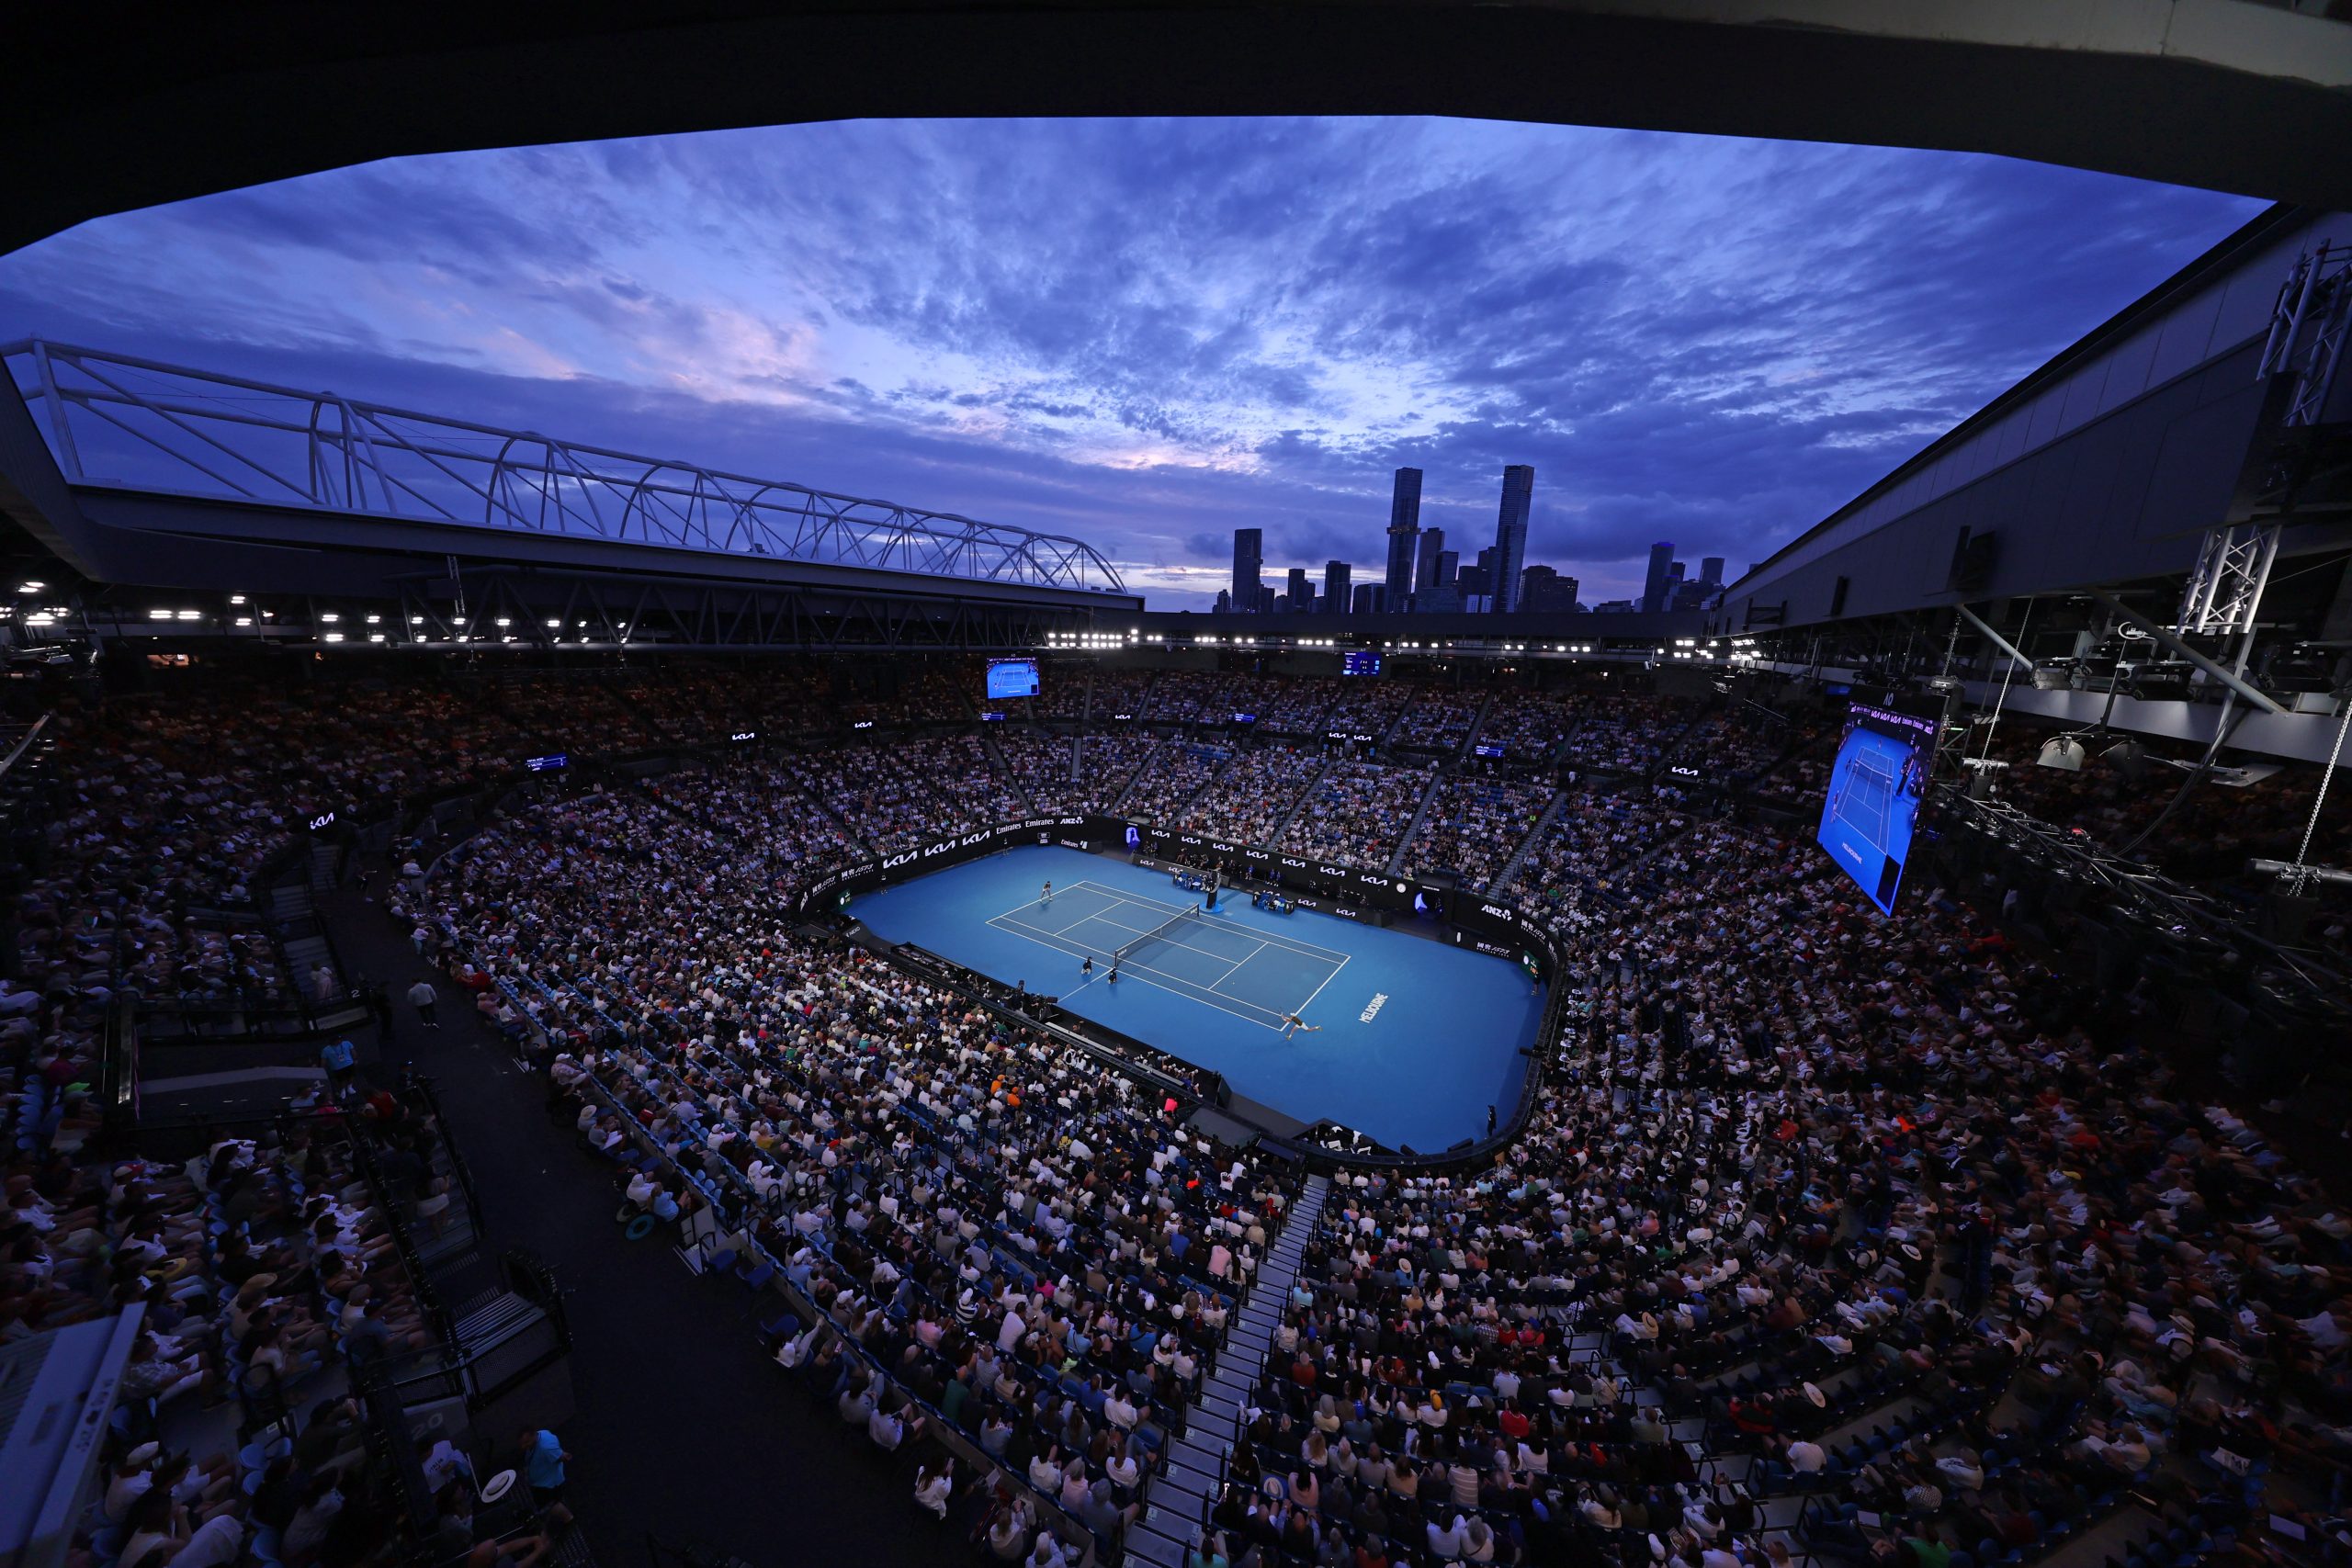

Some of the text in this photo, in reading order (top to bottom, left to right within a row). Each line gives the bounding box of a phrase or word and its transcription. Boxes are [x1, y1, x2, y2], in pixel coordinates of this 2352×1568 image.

[731, 732, 755, 741] KIA
[1671, 766, 1699, 776] KIA
[310, 811, 334, 830] KIA
[1025, 818, 1055, 829] Emirates
[996, 823, 1022, 835] Emirates
[883, 829, 990, 870] KIA KIA KIA
[1151, 829, 1388, 886] KIA KIA KIA KIA KIA KIA KIA
[1481, 904, 1502, 918] ANZ
[1358, 992, 1389, 1023] MELBOURNE
